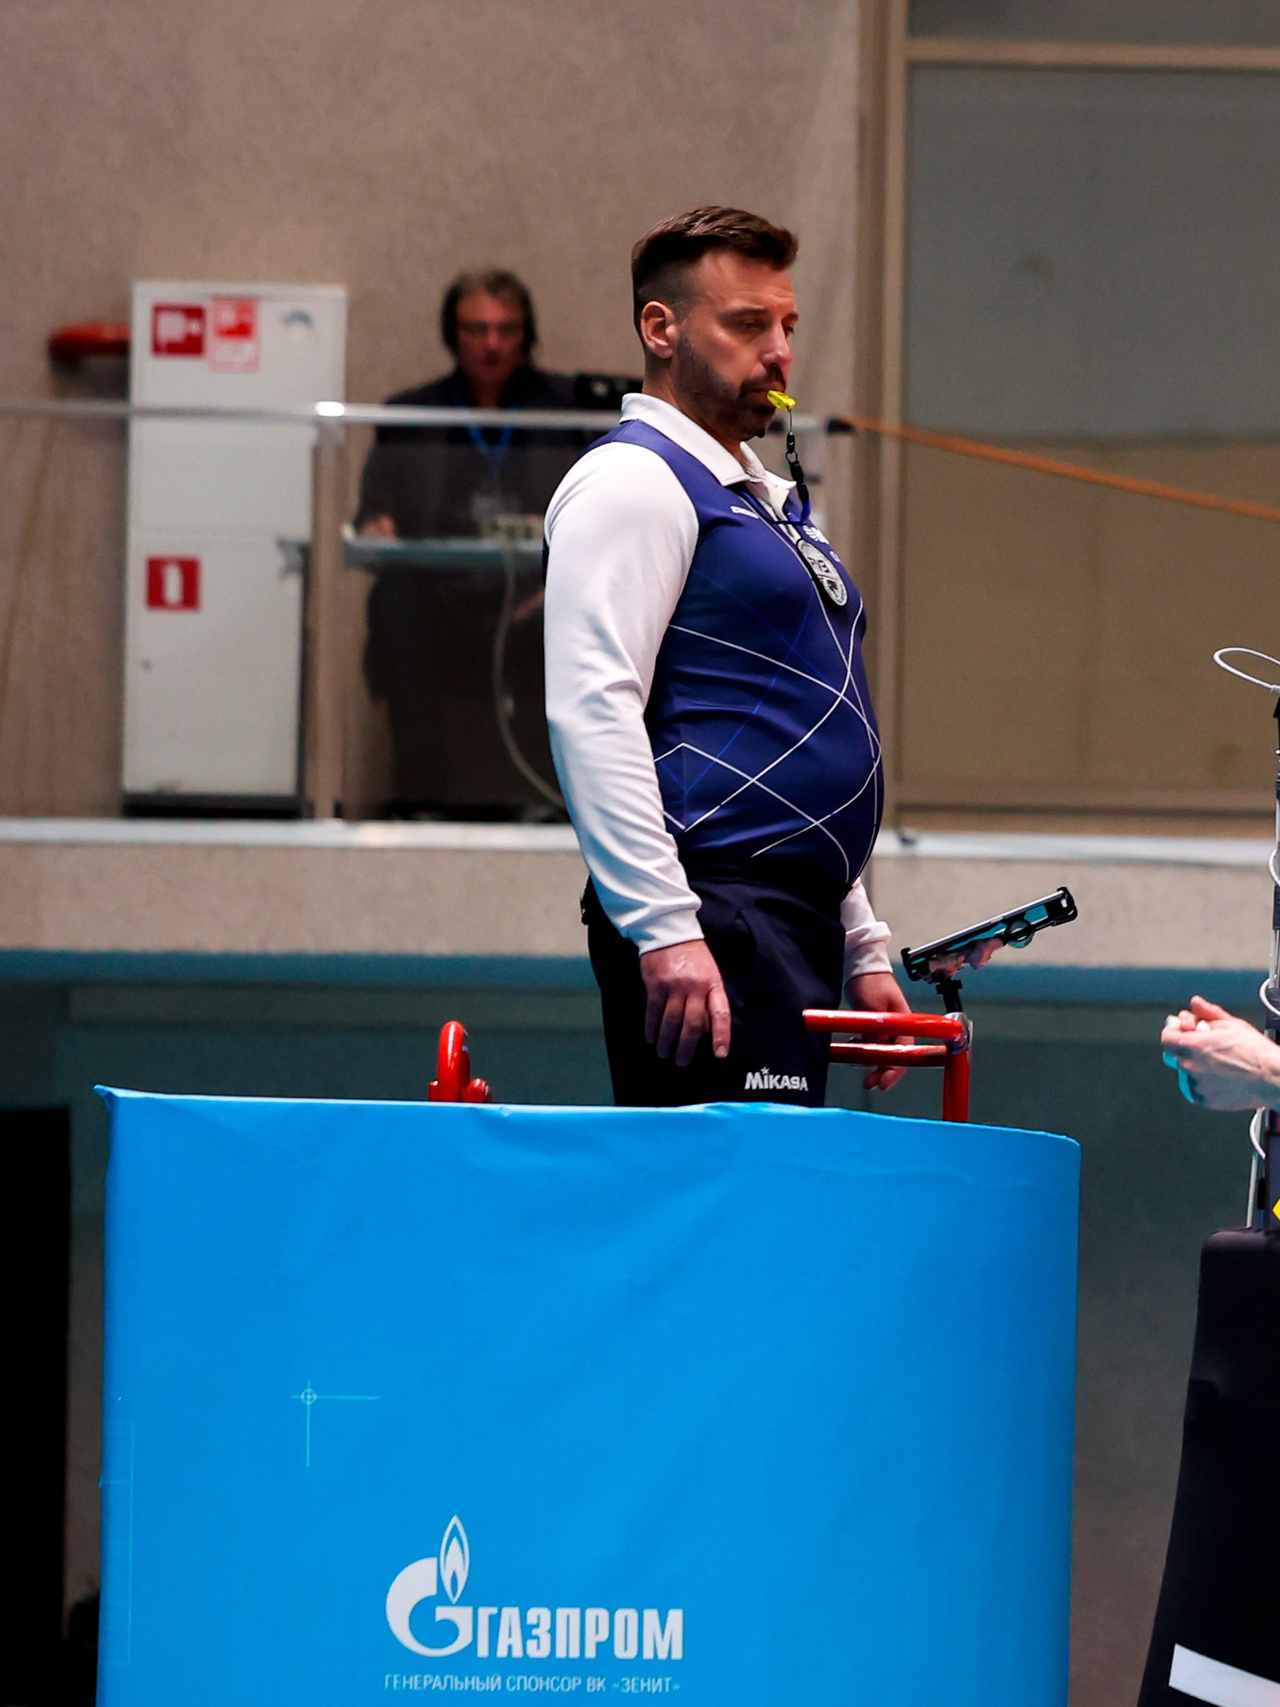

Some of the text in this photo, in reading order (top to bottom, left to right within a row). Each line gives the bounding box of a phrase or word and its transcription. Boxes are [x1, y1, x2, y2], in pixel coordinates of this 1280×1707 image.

[744, 1066, 809, 1091] MIKASA
[384, 1673, 502, 1692] ГЕНЕРАЛЬНЫЙ
[506, 1675, 582, 1693] СПОНСОР
[586, 1675, 607, 1693] ВК
